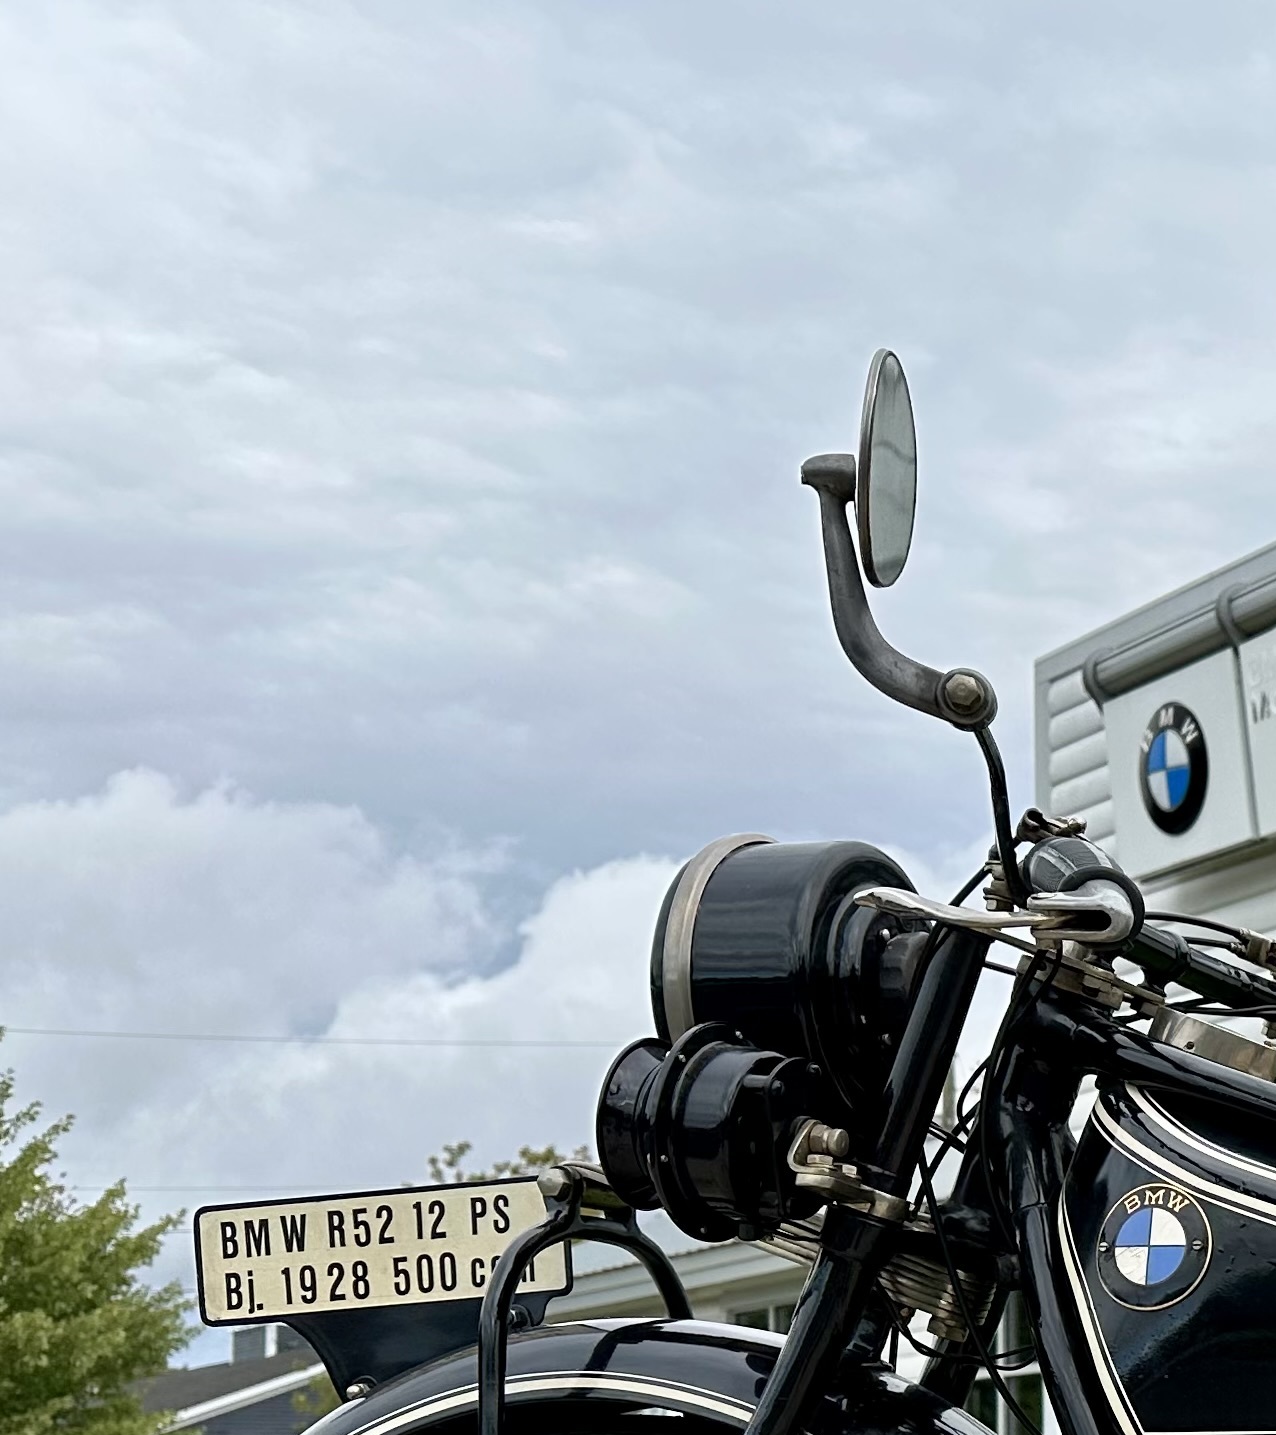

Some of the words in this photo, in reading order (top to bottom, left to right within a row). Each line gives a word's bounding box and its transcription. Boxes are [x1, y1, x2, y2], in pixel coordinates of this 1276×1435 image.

[1140, 706, 1200, 753] BMW
[219, 1213, 307, 1260] BMW
[327, 1204, 395, 1249] R52
[412, 1199, 447, 1240] 12
[470, 1194, 511, 1236] PS
[1123, 1189, 1191, 1215] BMW
[225, 1271, 264, 1314] Bj.
[281, 1260, 370, 1305] 1928
[393, 1251, 458, 1297] 500
